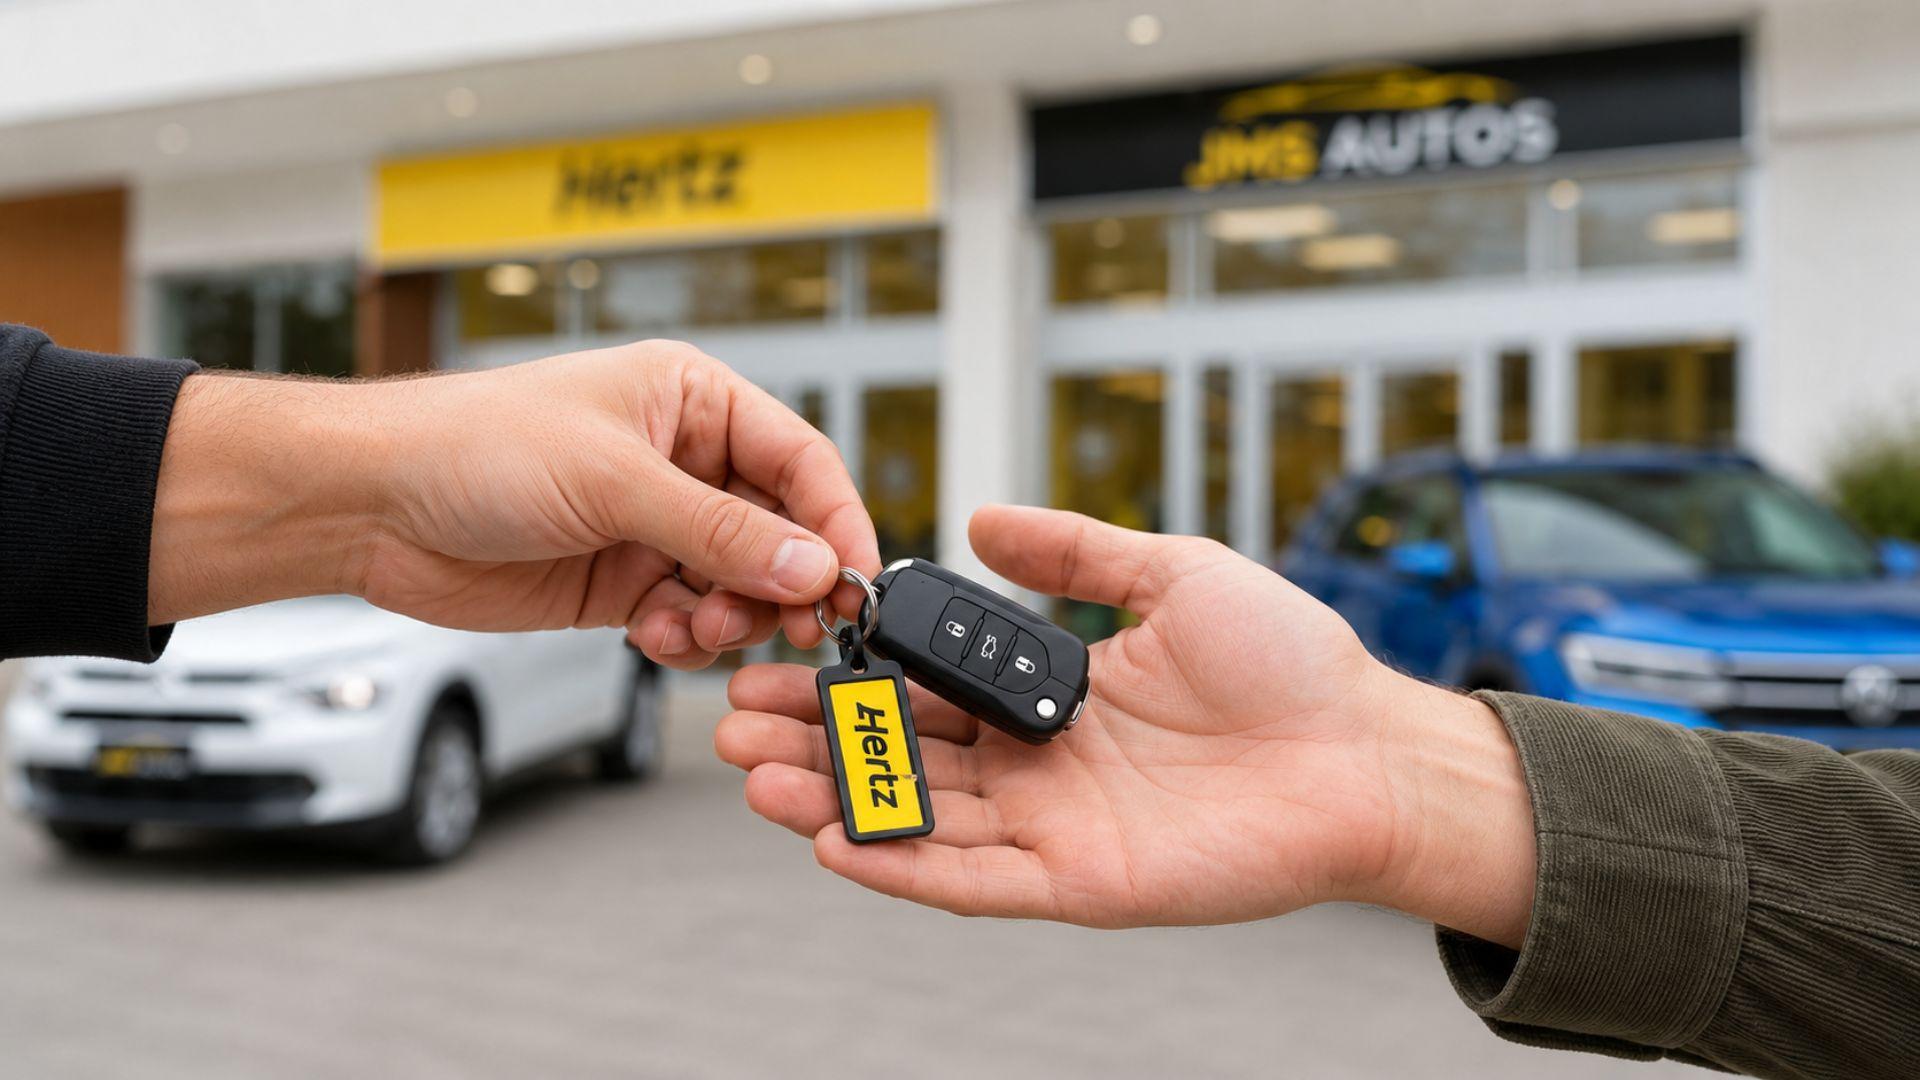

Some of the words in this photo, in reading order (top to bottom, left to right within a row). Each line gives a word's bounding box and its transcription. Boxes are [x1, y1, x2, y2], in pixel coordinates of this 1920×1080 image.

[556, 143, 748, 221] Hertz
[1185, 122, 1319, 189] JMS
[1320, 99, 1559, 179] AUTOS
[854, 701, 899, 809] Hertz
